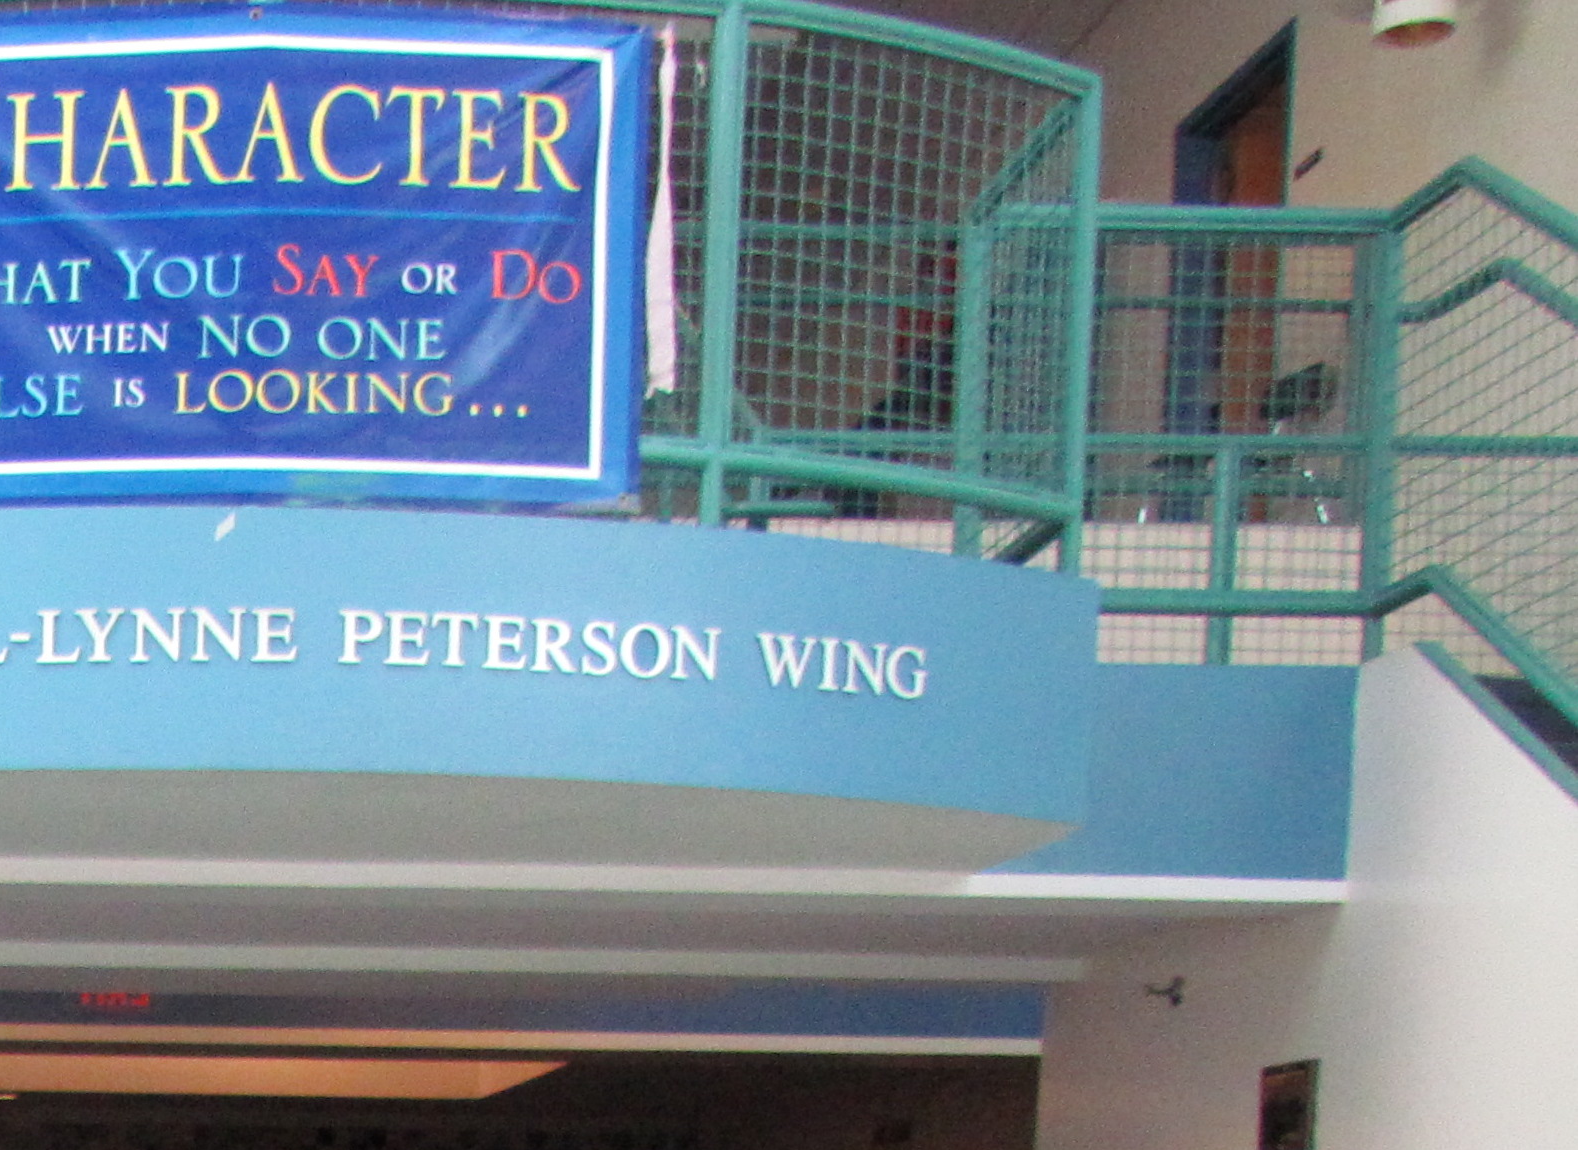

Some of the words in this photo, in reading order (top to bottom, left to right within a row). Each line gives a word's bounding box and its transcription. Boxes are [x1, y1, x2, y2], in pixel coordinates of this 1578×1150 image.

[114, 249, 243, 300] YOU
[273, 244, 379, 297] SAY
[401, 262, 457, 294] OR
[490, 249, 582, 303] DO
[46, 321, 170, 354] WHEN
[198, 313, 291, 358] NO
[317, 316, 446, 360] ONE
[113, 377, 145, 407] IS
[338, 609, 722, 680] PETERSON
[758, 633, 928, 699] WING
